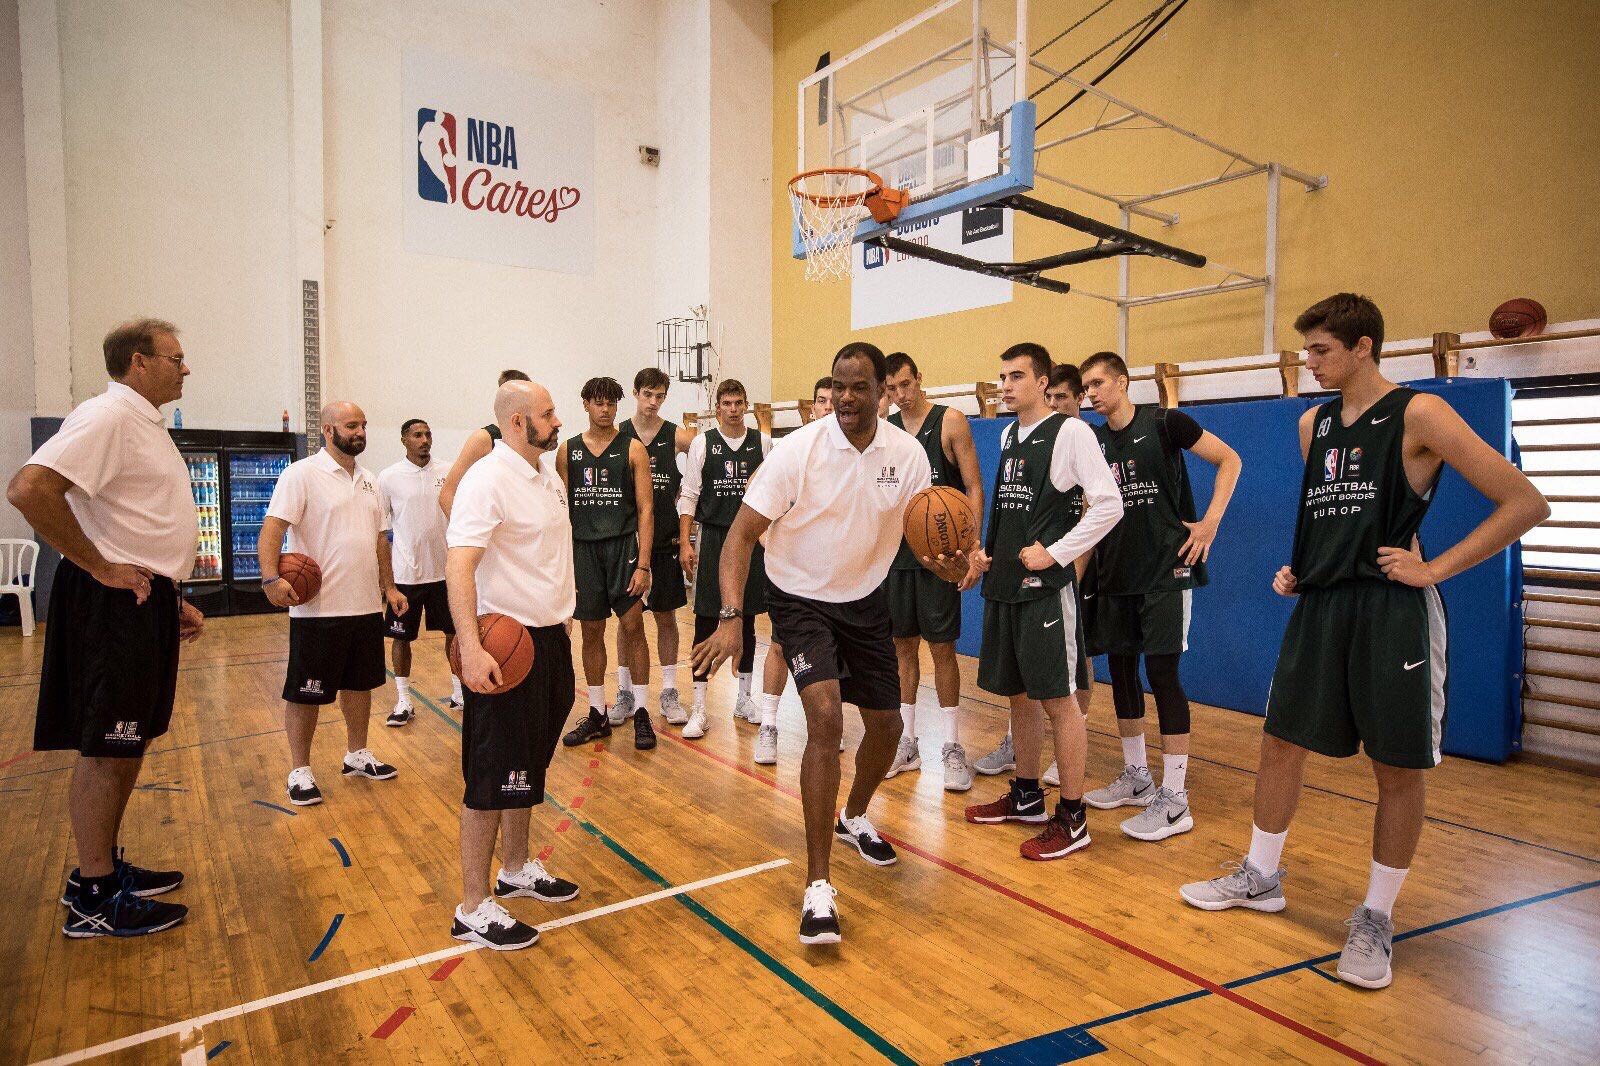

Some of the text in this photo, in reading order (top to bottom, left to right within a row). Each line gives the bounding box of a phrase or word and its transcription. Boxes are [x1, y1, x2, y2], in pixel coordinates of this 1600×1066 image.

[467, 117, 518, 170] NBA
[461, 168, 562, 223] Cares
[866, 246, 880, 266] NBA
[571, 450, 583, 461] 58
[712, 444, 723, 455] 62
[1119, 480, 1158, 493] KETBALL
[1123, 497, 1155, 508] ROPE
[1313, 505, 1362, 520] EUROP
